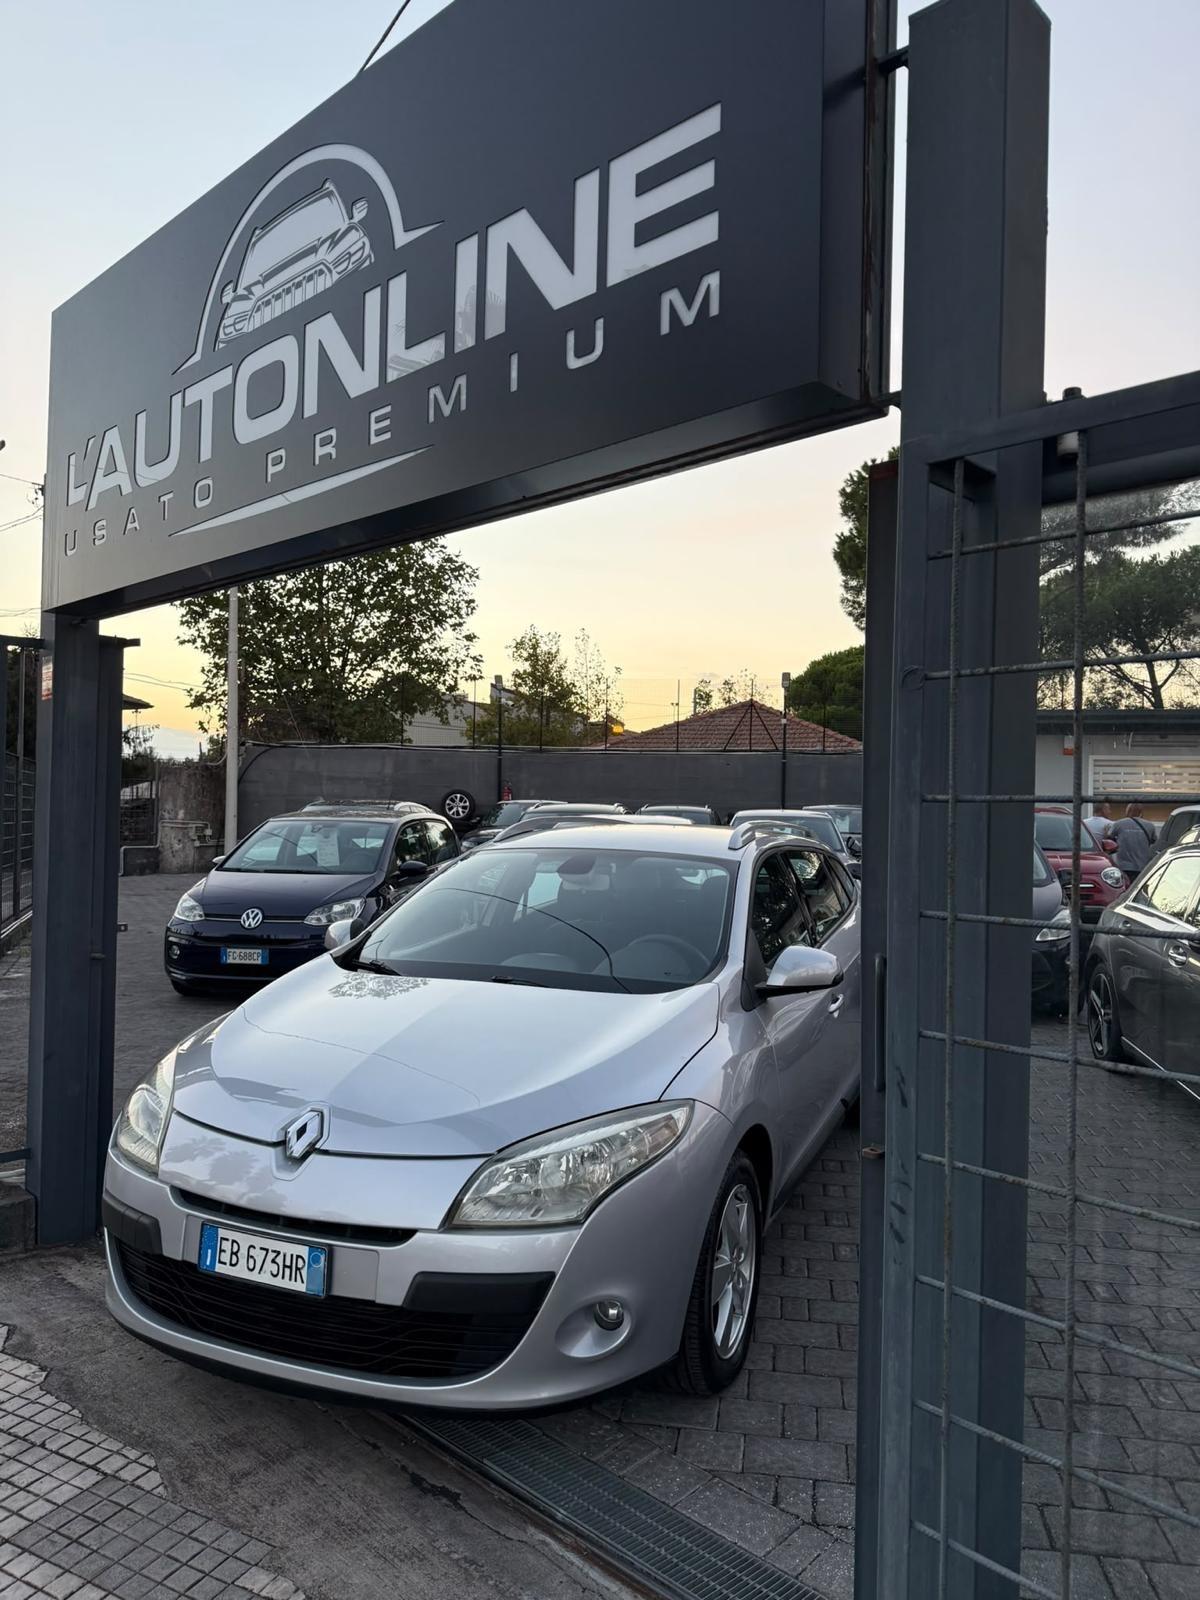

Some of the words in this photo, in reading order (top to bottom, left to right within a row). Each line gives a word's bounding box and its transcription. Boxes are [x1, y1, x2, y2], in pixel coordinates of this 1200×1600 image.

[64, 477, 214, 557] USATO
[265, 269, 721, 483] PREMIUM
[217, 1236, 241, 1268] EB
[246, 1244, 306, 1285] 673HR
